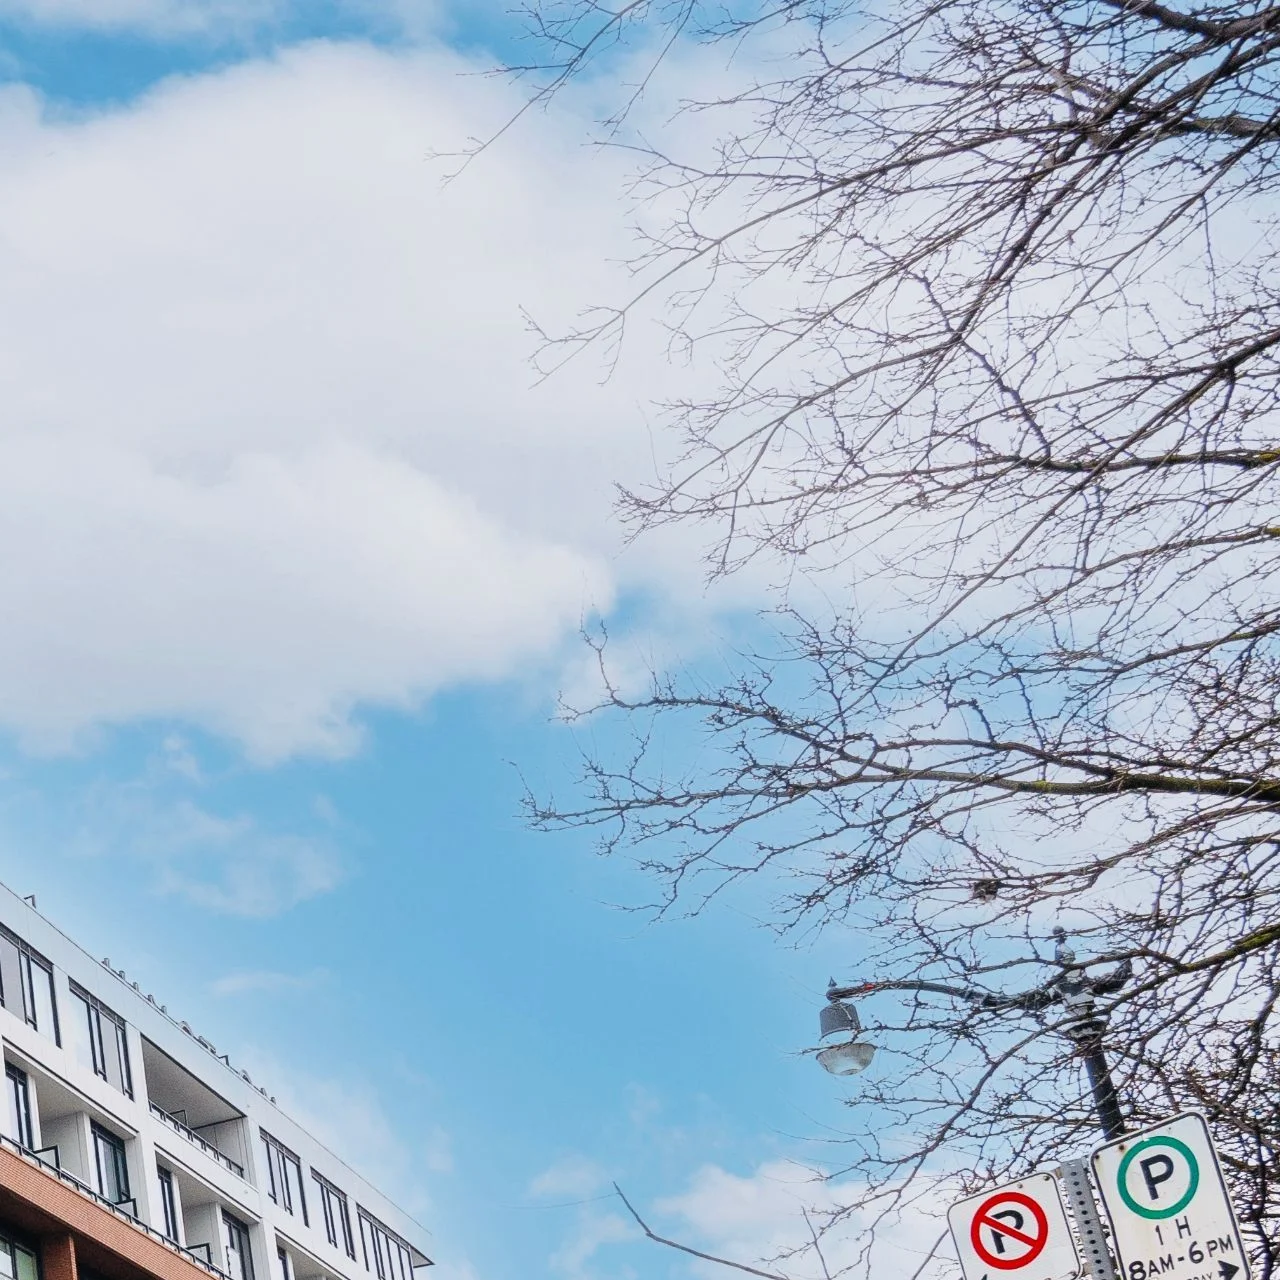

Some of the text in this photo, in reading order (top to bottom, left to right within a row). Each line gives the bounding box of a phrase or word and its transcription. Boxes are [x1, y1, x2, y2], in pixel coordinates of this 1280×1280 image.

[1140, 1154, 1174, 1200] P
[1155, 1216, 1191, 1245] 1 H
